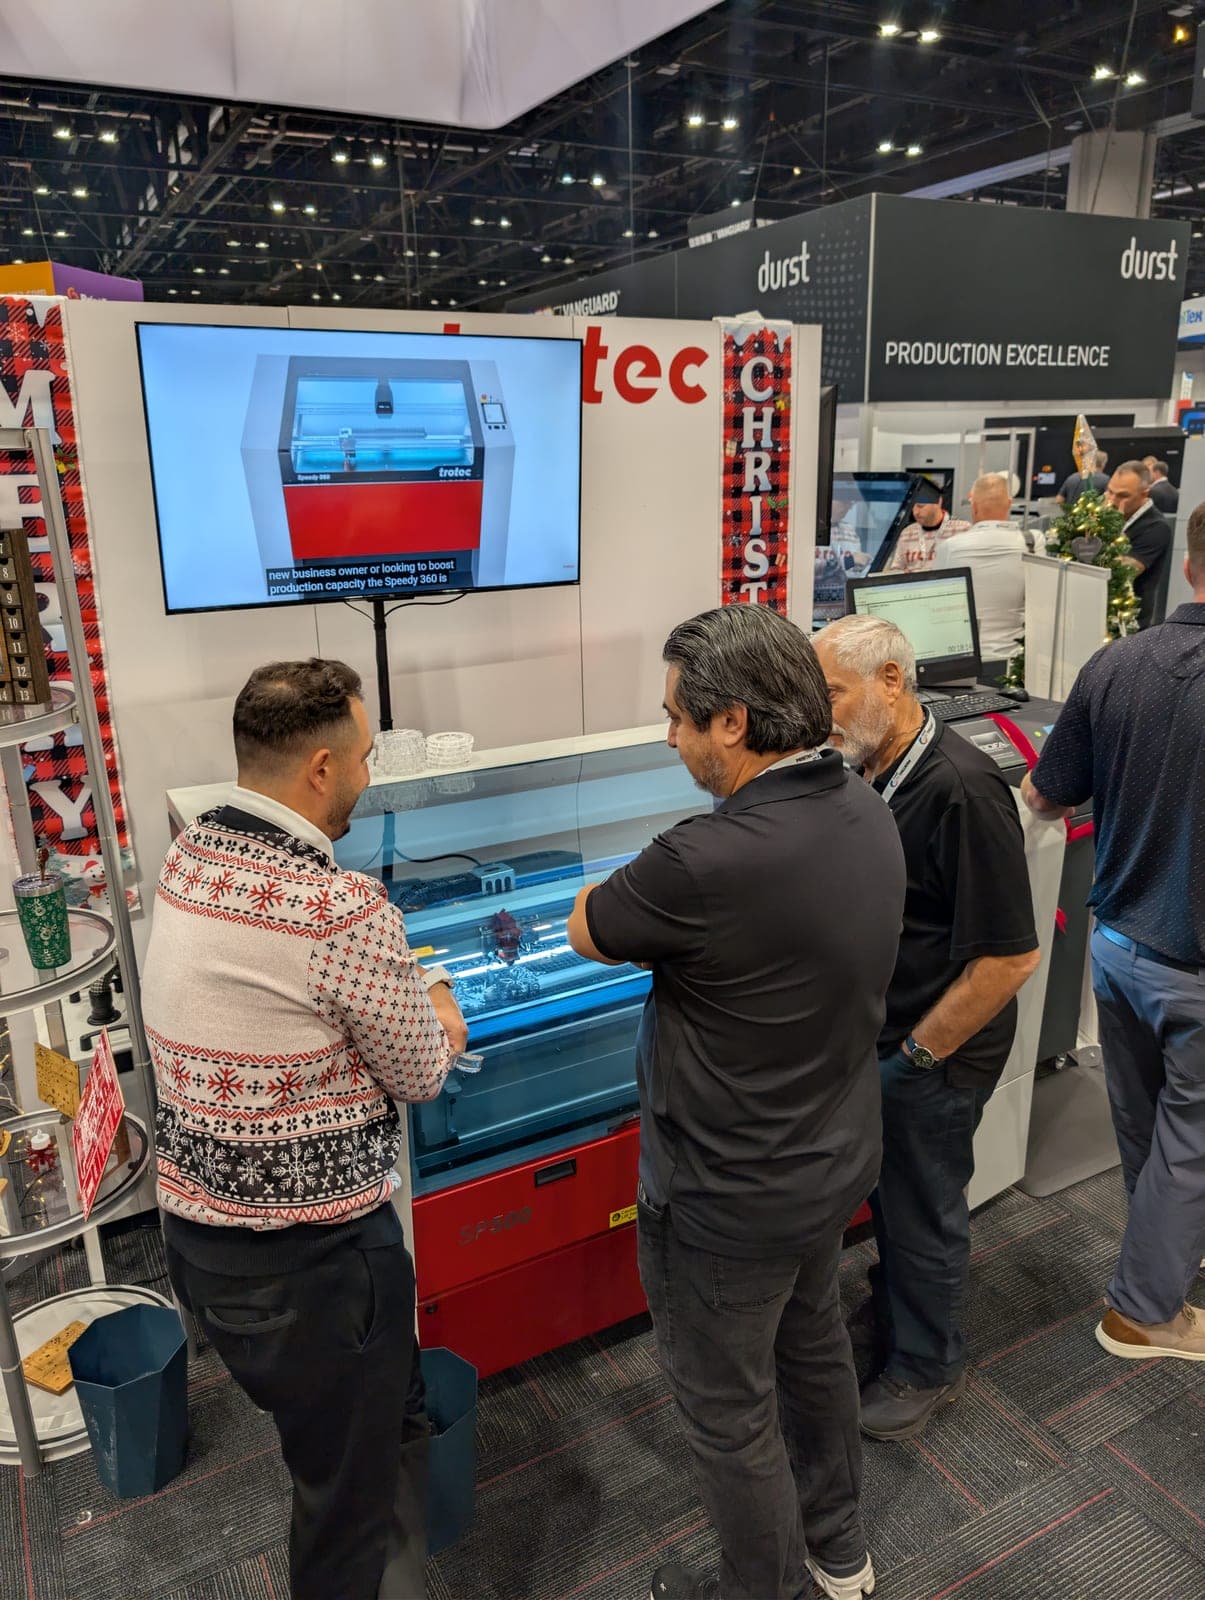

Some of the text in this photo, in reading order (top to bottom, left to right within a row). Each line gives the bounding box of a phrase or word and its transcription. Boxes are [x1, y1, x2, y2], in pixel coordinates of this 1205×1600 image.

[758, 240, 810, 293] durst
[1121, 236, 1178, 280] durst
[562, 290, 618, 317] VANGUARD
[885, 341, 1111, 367] PRODUCTION EXCELLENCE
[438, 467, 472, 478] trotec
[3, 567, 9, 578] 8
[268, 559, 455, 581] new business owner or looking to boost
[270, 572, 447, 595] production capacity the Speedy 360 is
[6, 592, 13, 604] 9
[8, 617, 18, 629] 10
[12, 642, 22, 653] 11
[16, 666, 27, 677] 12
[19, 690, 30, 701] 13
[457, 1205, 533, 1247] SP500
